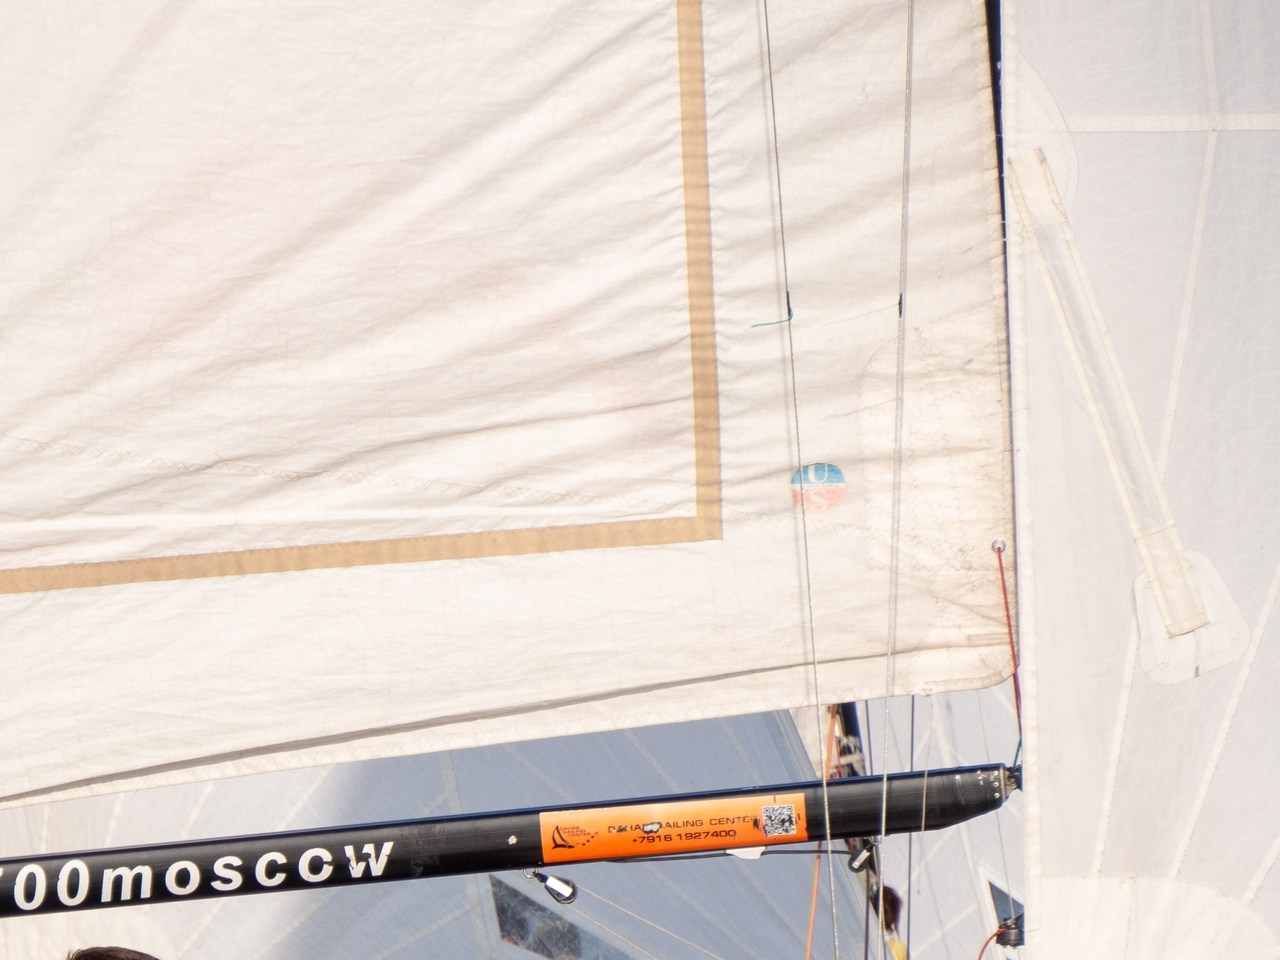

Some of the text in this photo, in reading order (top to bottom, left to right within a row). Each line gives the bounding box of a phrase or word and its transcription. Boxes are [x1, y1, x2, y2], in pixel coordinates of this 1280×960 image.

[658, 819, 704, 830] AILING
[632, 829, 737, 845] +7916 1927400
